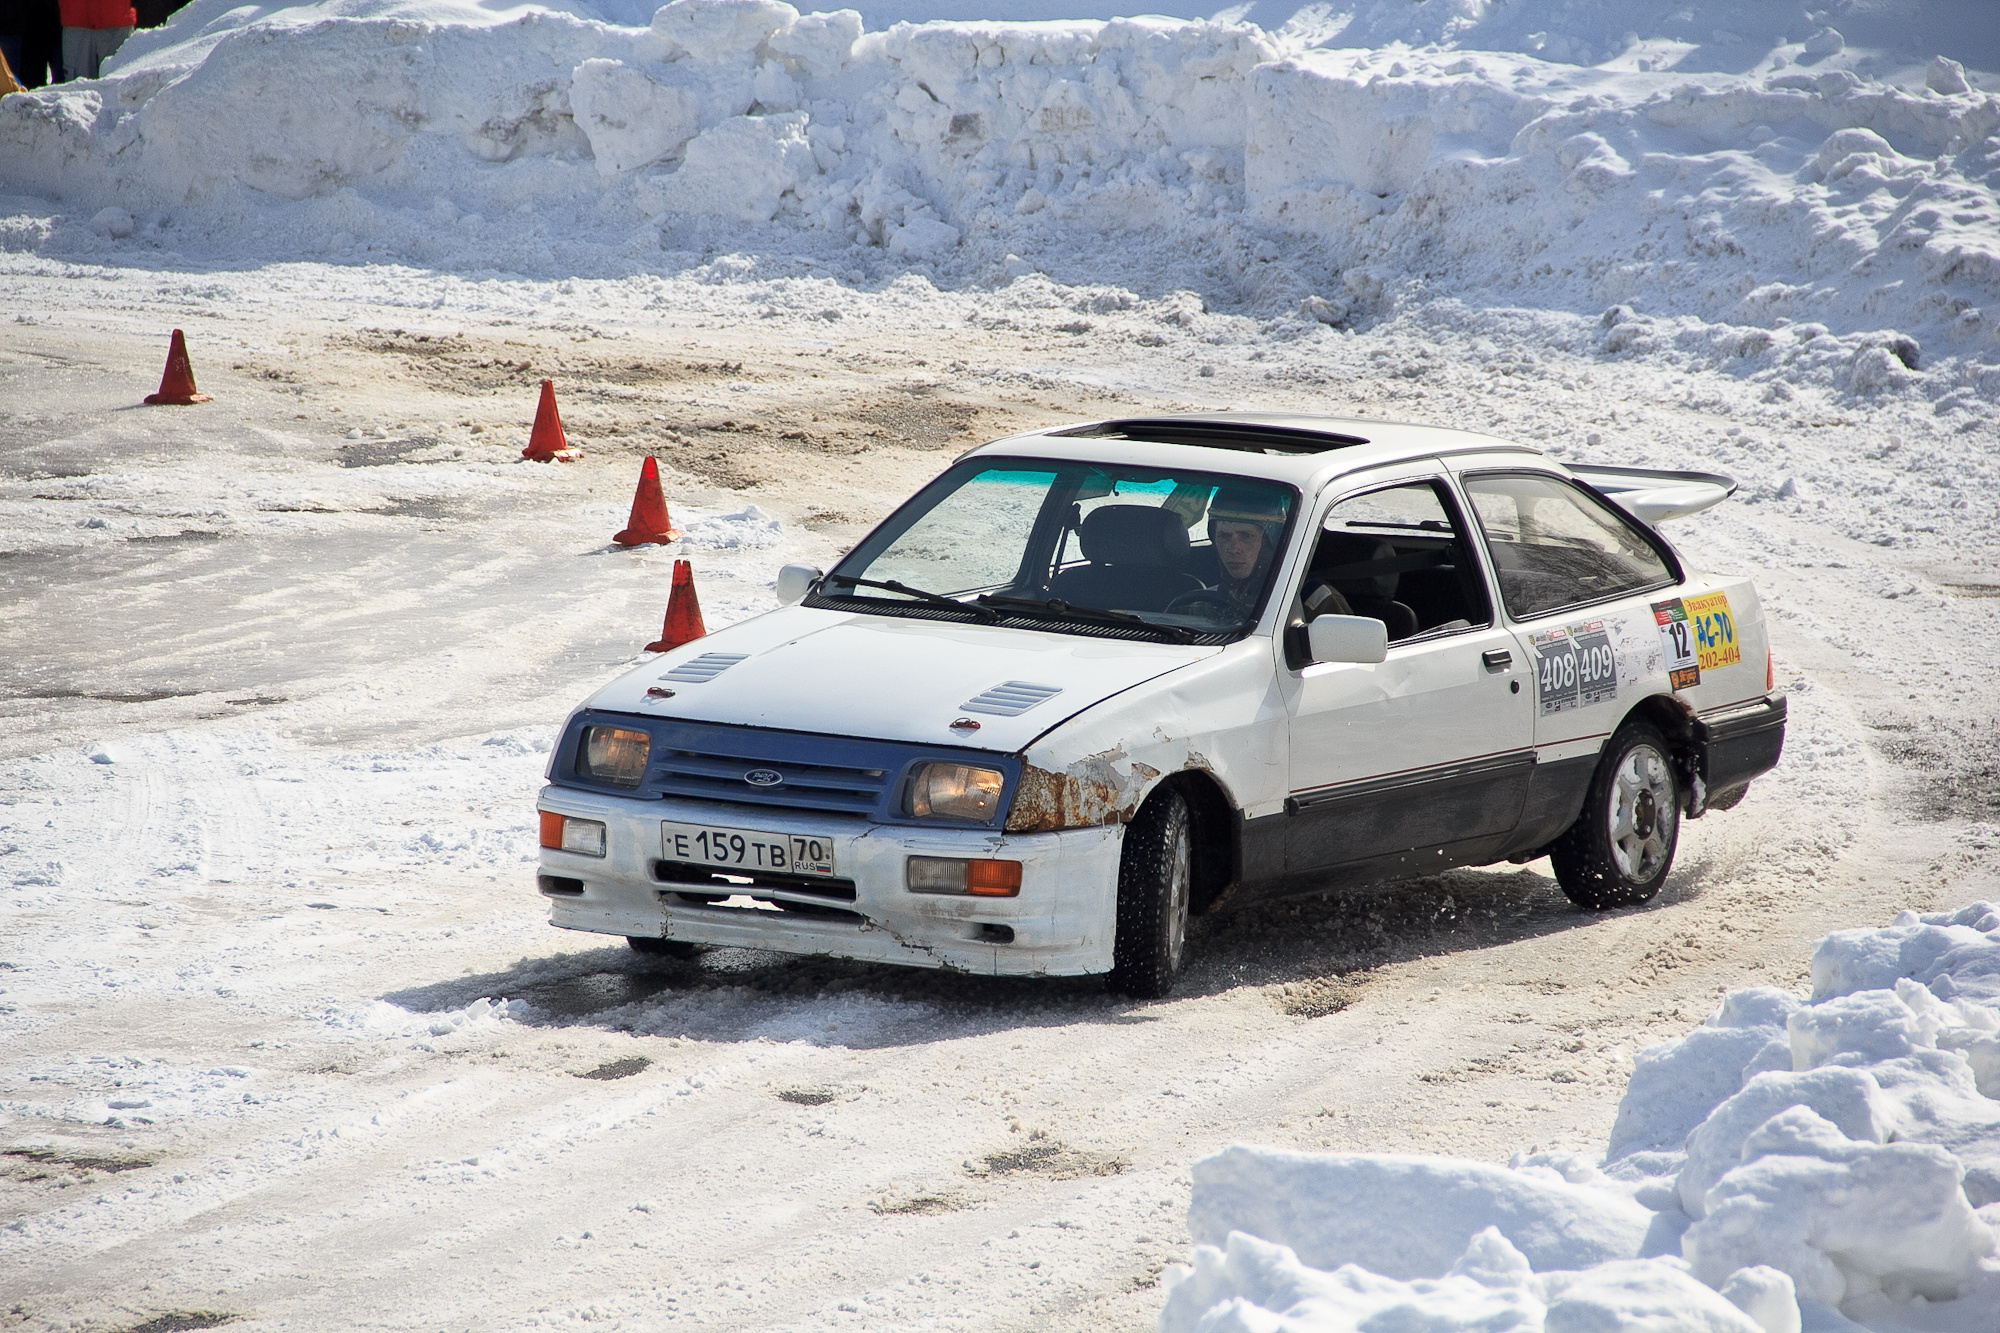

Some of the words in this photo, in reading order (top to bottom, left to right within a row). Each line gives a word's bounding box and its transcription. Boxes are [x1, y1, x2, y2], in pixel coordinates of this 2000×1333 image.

[1684, 594, 1728, 612] Эвакуатор
[1669, 622, 1691, 659] 12
[1580, 644, 1613, 683] 409
[1699, 645, 1741, 670] 202-404
[1540, 652, 1575, 692] 408
[793, 838, 823, 862] 70
[795, 861, 816, 871] RUS
